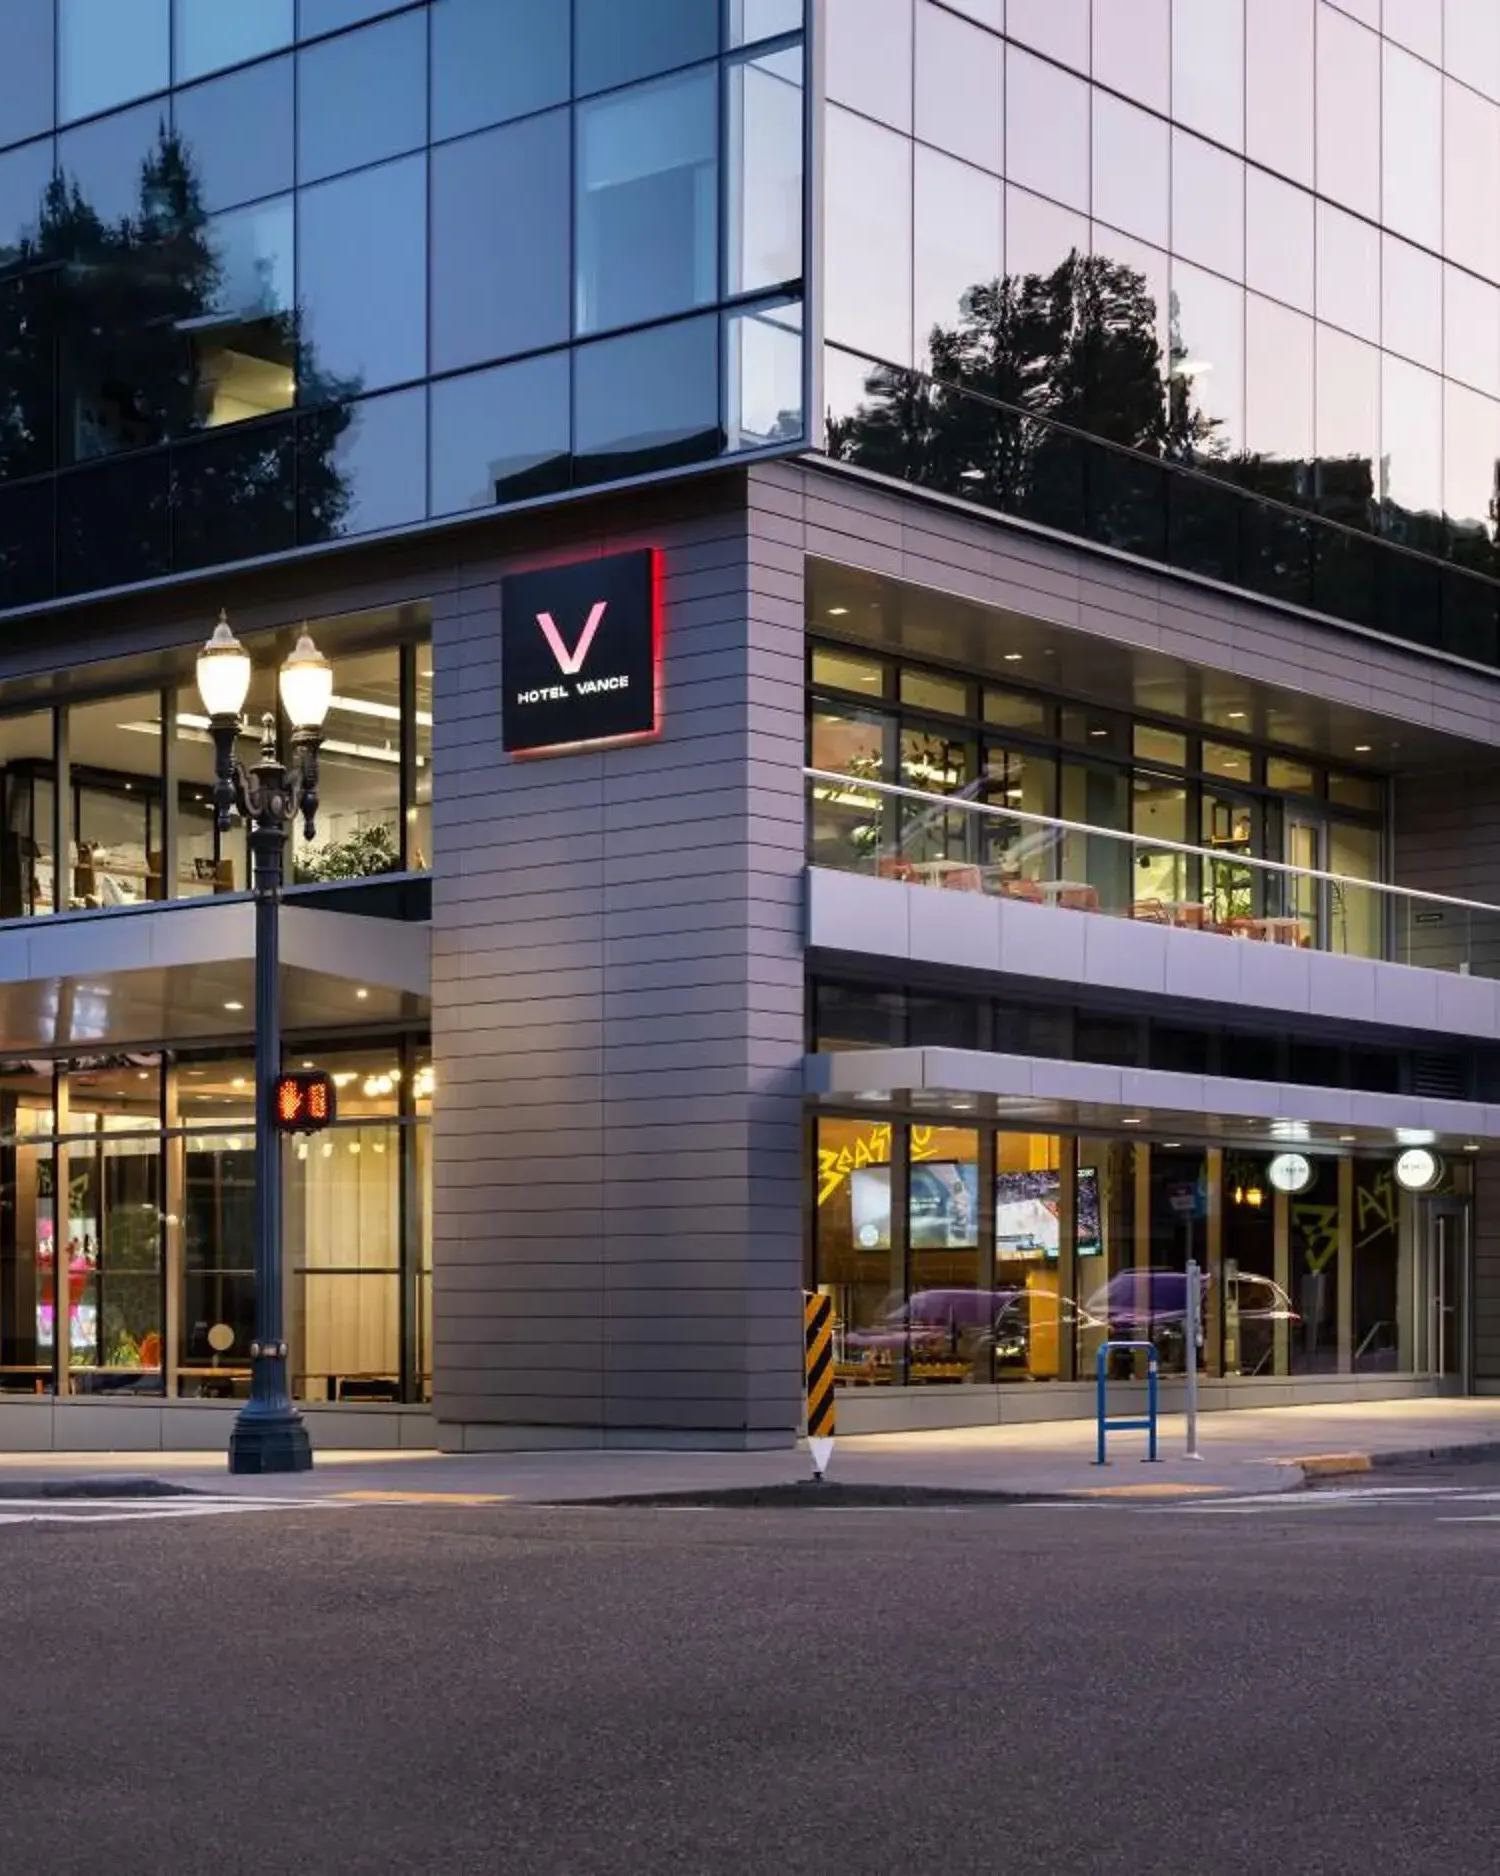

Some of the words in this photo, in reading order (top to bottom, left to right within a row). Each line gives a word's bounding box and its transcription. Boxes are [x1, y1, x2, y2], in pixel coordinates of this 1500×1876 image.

[536, 601, 608, 675] V
[517, 684, 569, 704] HOTEL
[576, 676, 629, 695] VANCE
